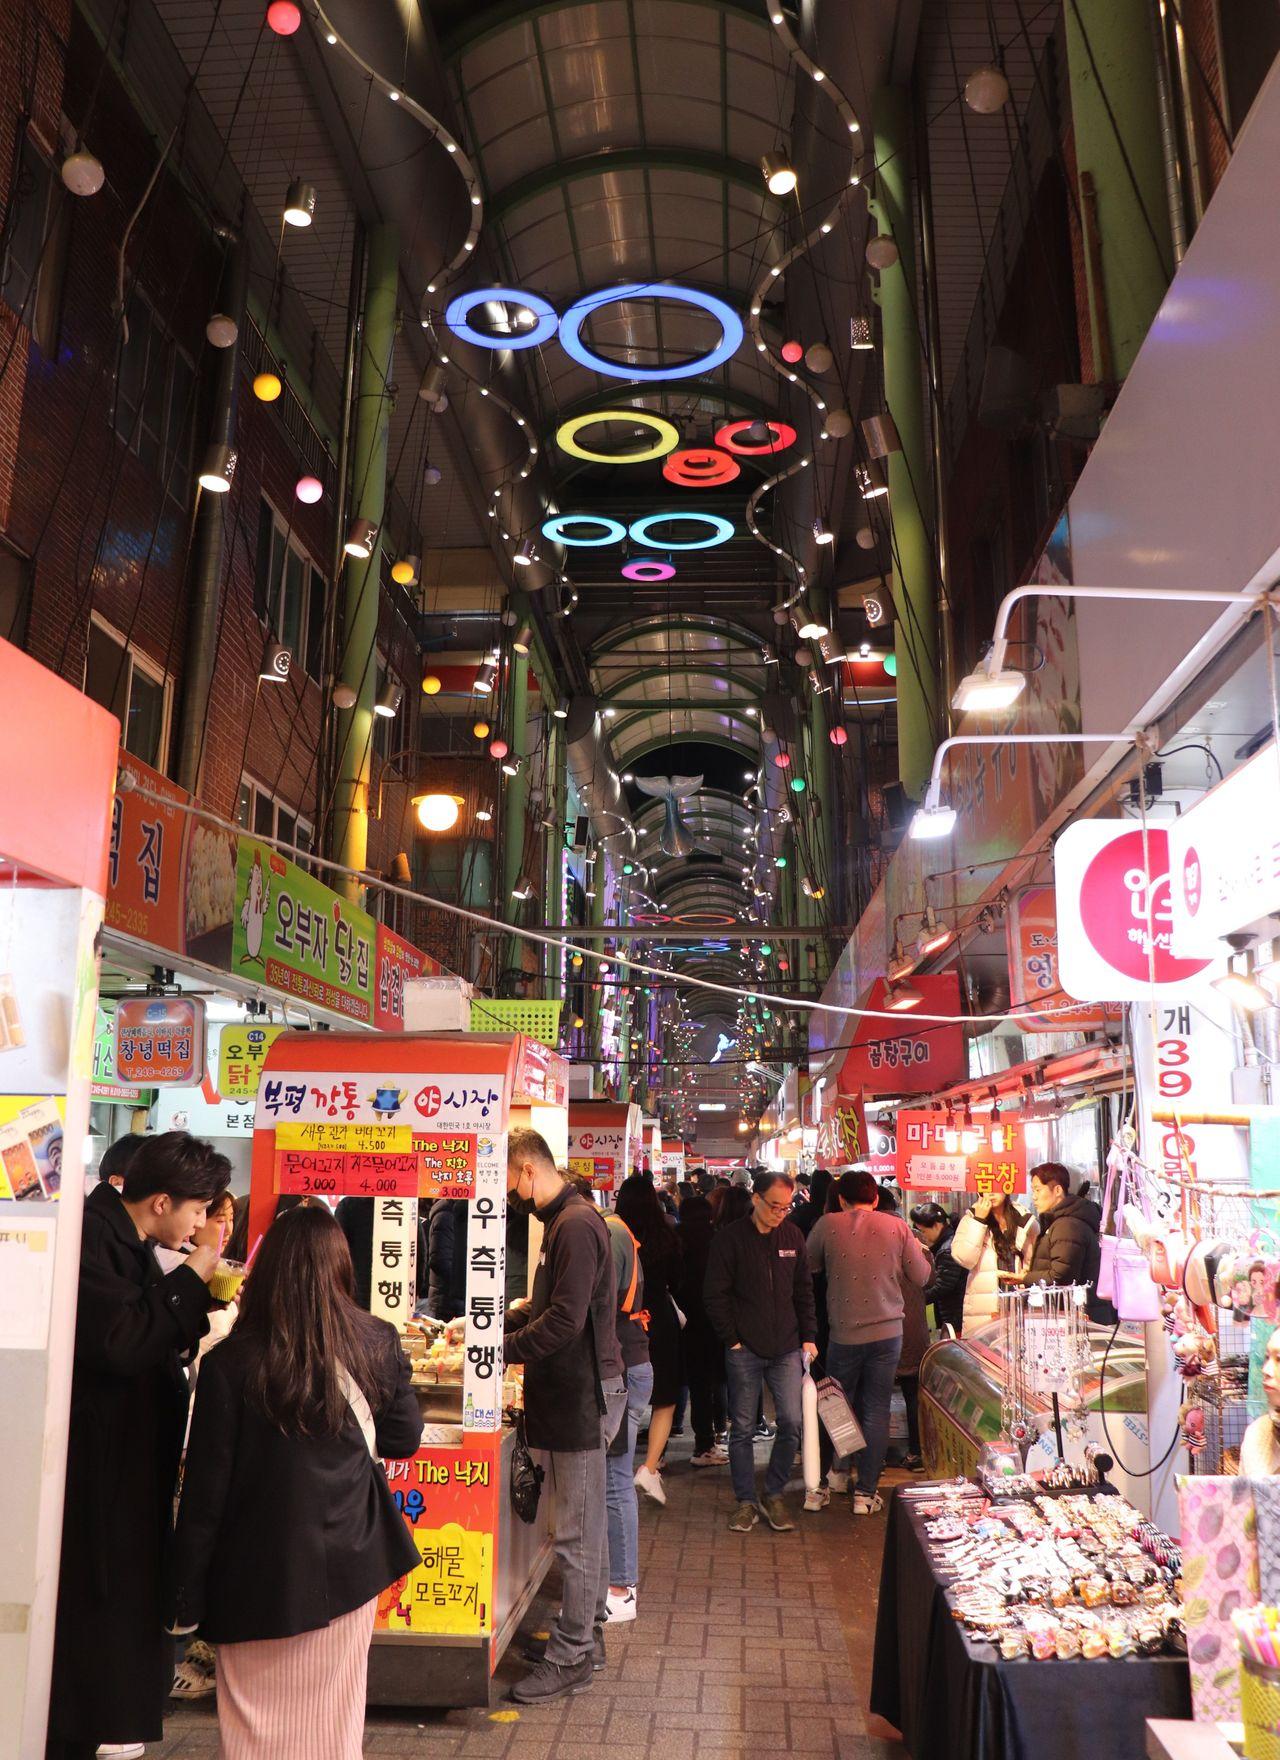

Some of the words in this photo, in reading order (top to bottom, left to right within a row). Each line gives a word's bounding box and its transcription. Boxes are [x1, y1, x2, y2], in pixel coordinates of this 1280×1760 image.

[274, 891, 329, 970] 오부자
[334, 915, 370, 992] 닭집
[1164, 1006, 1191, 1036] 개
[248, 1032, 264, 1041] C14
[226, 1045, 271, 1061] 오부
[868, 1039, 930, 1069] 곱창구이
[264, 1080, 307, 1116] 부평
[311, 1082, 361, 1120] 깡통
[414, 1086, 499, 1117] 야시장
[226, 1114, 255, 1128] 본점
[436, 1122, 461, 1130] 대한민국
[472, 1122, 491, 1130] 야시장
[301, 1124, 326, 1141] 새우
[358, 1140, 386, 1151] 4.500
[412, 1139, 439, 1151] The
[442, 1139, 469, 1152] 낙지
[580, 1133, 623, 1149] 야시장
[284, 1153, 346, 1174] 문어꼬지
[350, 1154, 419, 1174] 치즈문어꼬지
[424, 1157, 443, 1168] The
[302, 1176, 336, 1192] 3.000
[360, 1178, 397, 1192] 4.000
[431, 1170, 453, 1183] 낙지
[974, 1162, 1019, 1195] 곱창
[441, 1186, 470, 1198] 3.000
[467, 1197, 499, 1380] 우측통행
[415, 1460, 449, 1485] The
[454, 1460, 490, 1487] 낙지
[421, 1546, 465, 1578] 해물
[415, 1582, 479, 1616] 모듬꼬지
